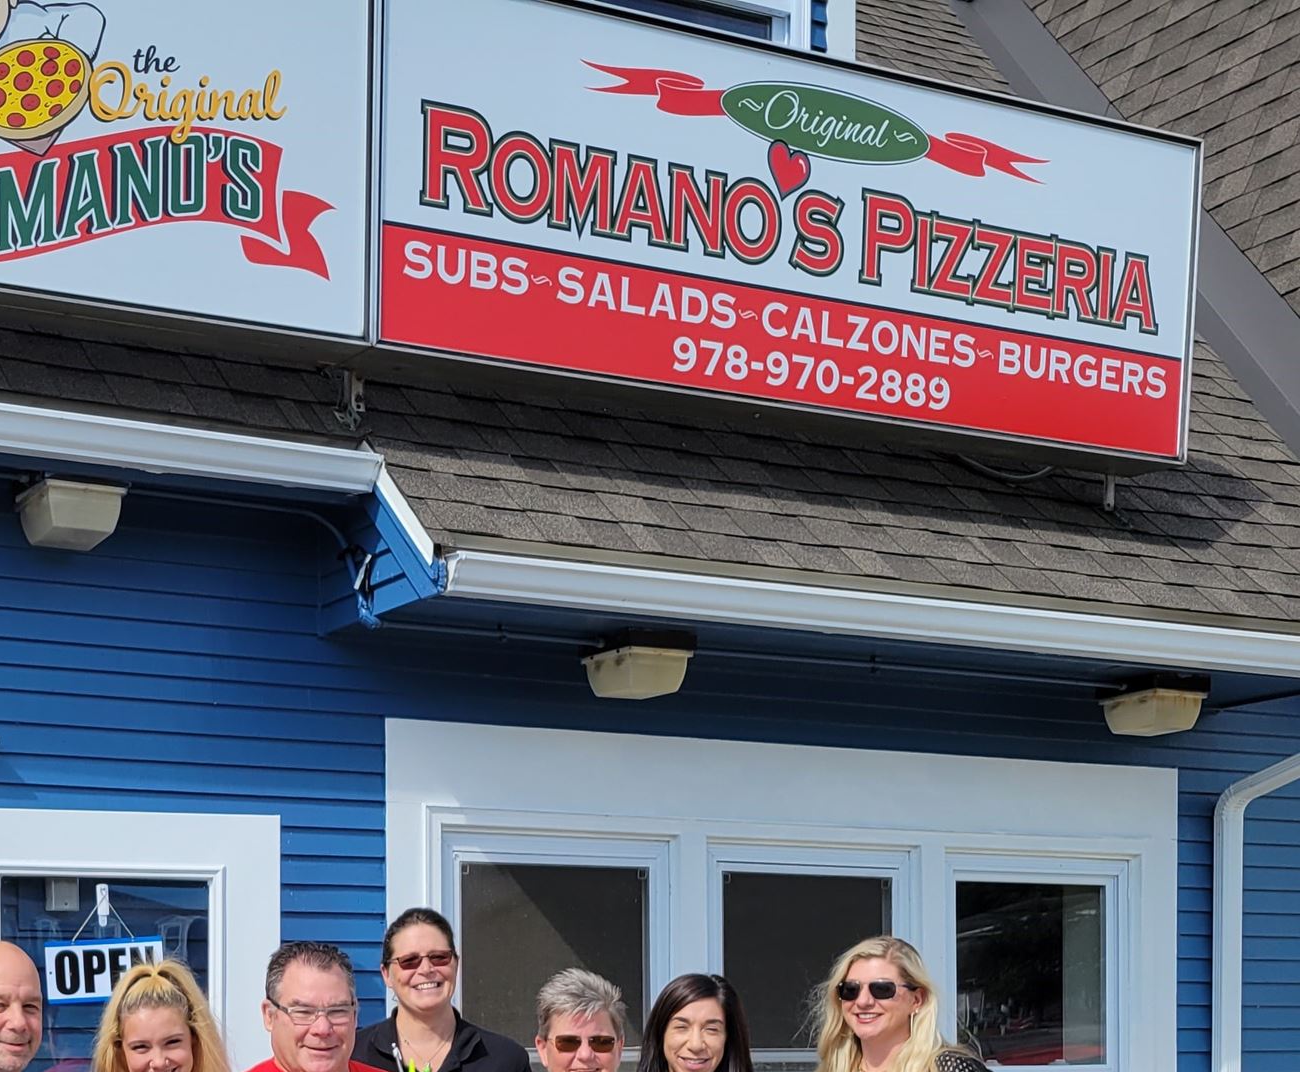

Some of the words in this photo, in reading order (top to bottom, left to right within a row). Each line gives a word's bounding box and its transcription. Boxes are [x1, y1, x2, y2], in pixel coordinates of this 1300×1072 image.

[133, 45, 180, 73] the
[88, 61, 288, 144] Original
[763, 90, 891, 149] Original
[859, 187, 1159, 336] PIZZERIA
[403, 240, 530, 295] SUBS
[557, 267, 737, 329] SALADS
[761, 302, 977, 369] CALZONES
[998, 342, 1167, 399] BURGERS
[672, 336, 950, 410] 978-970-2889
